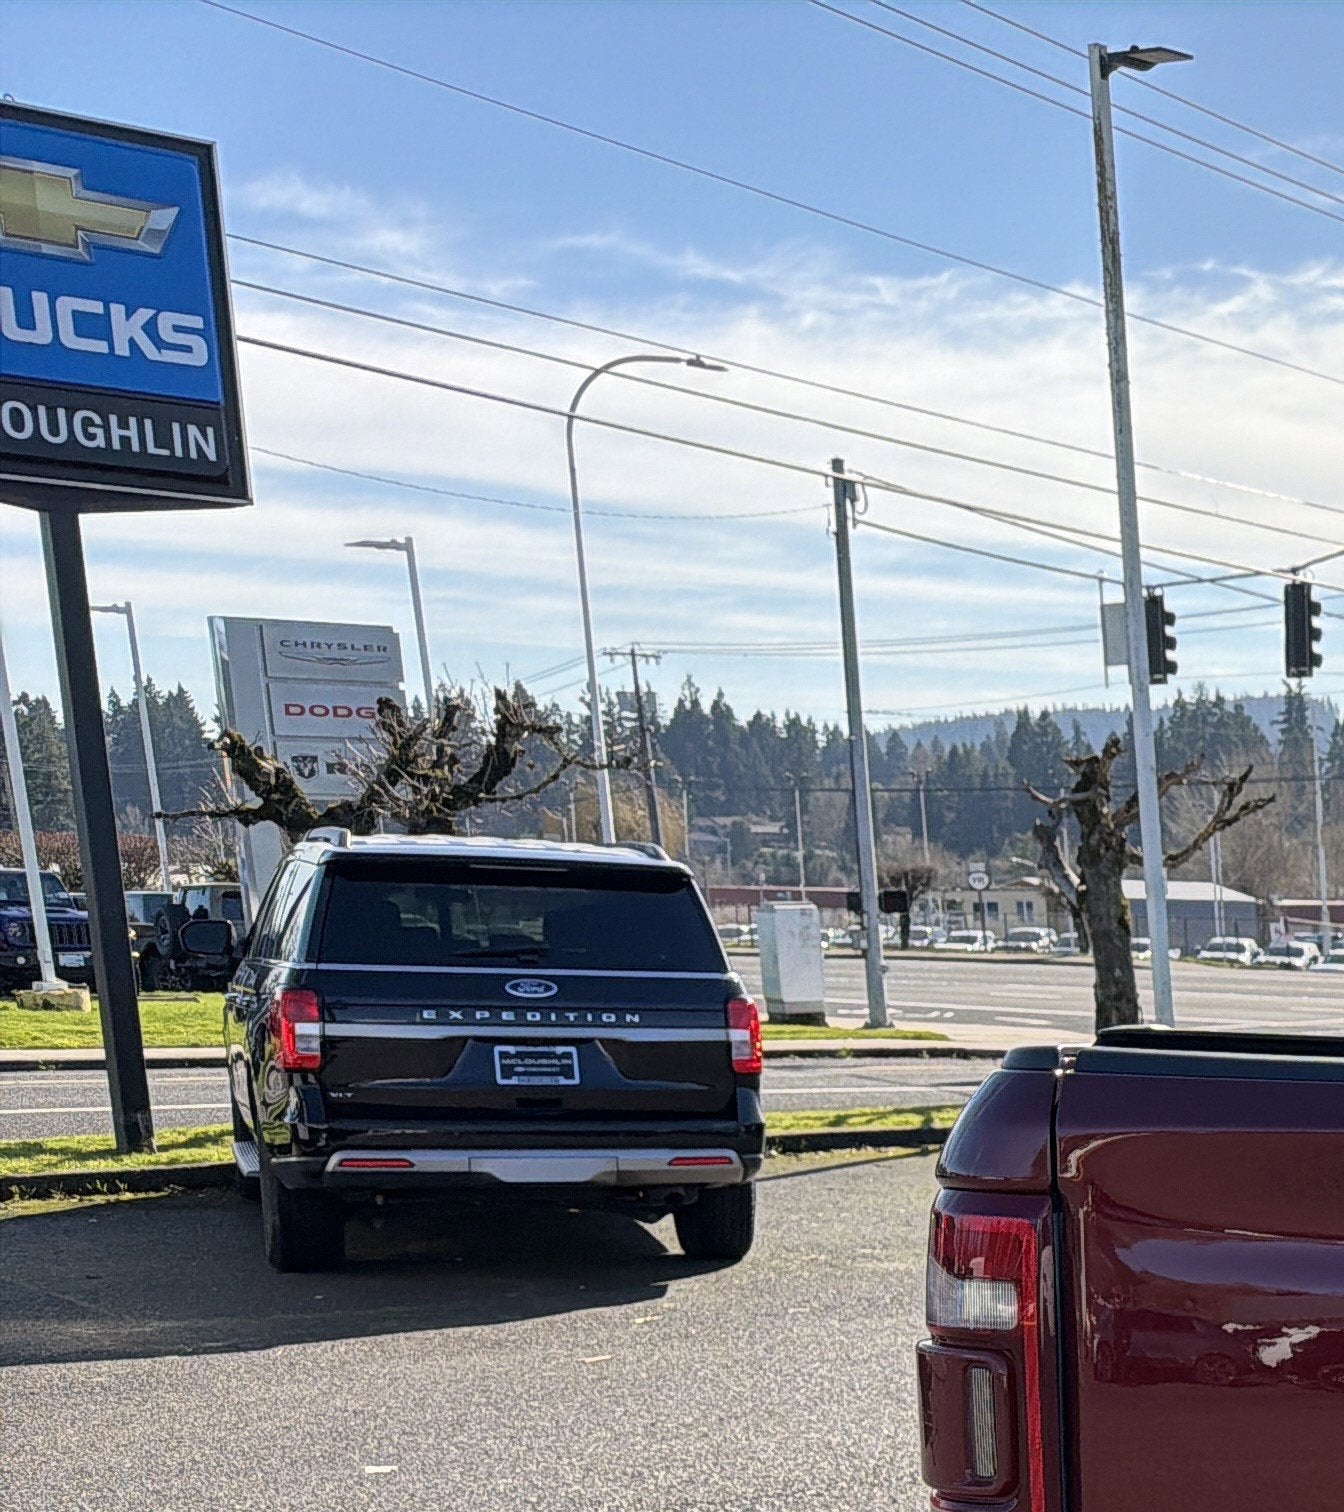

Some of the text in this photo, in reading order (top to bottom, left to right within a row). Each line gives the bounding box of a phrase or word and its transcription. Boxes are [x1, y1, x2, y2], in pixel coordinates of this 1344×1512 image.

[278, 639, 388, 653] CHRYSLER
[283, 703, 376, 720] DODG
[422, 1009, 641, 1024] EXPEDITION
